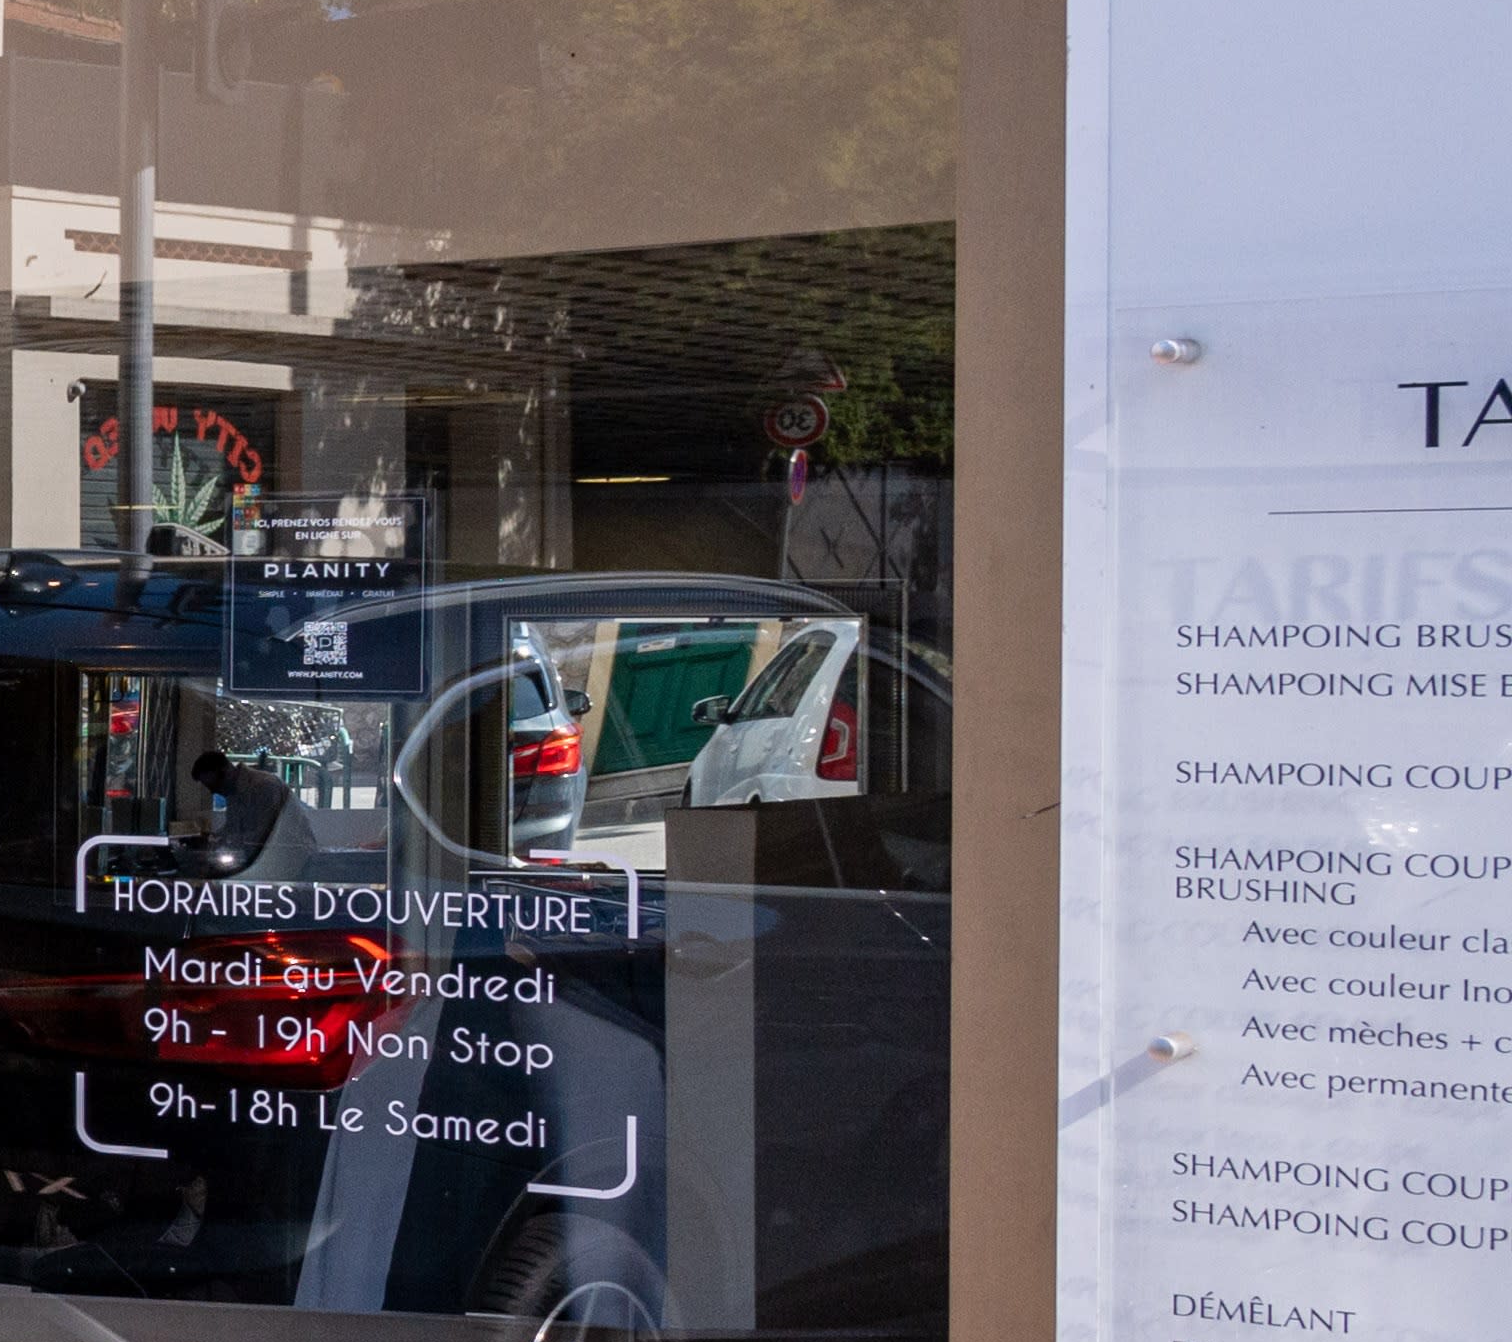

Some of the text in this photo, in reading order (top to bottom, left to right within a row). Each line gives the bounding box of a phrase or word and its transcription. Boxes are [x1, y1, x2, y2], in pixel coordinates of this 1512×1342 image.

[1398, 378, 1512, 448] TA
[264, 562, 391, 579] PLANITY
[1176, 623, 1512, 649] SHAMPOING BRUS
[1176, 672, 1394, 697] SHAMPOING
[1406, 672, 1488, 698] MISE
[1175, 760, 1512, 791] SHAMPOING COUP
[1175, 846, 1512, 880] SHAMPOING COUP
[114, 879, 591, 934] HORAIRES D'OUVERTURE
[1175, 876, 1356, 906] BRUSHING
[1242, 920, 1318, 946] Avec
[1328, 924, 1452, 952] couleur
[145, 946, 556, 1005] Mardi au Vendredi
[1242, 968, 1317, 994] Avec
[1328, 972, 1451, 1001] couleur
[144, 1008, 191, 1044] 9h
[258, 1014, 326, 1054] 19h
[347, 1021, 429, 1060] Non
[450, 1027, 554, 1075] Stop
[1241, 1015, 1317, 1042] Avec
[1328, 1021, 1449, 1050] mèches
[1241, 1063, 1512, 1105] Avec permanente
[150, 1083, 547, 1149] 9h-18h Le Samedi
[1172, 1152, 1512, 1202] SHAMPOING COUP
[1172, 1199, 1512, 1251] SHAMPOING COUP
[1172, 1291, 1356, 1334] DÉMÊLANT
